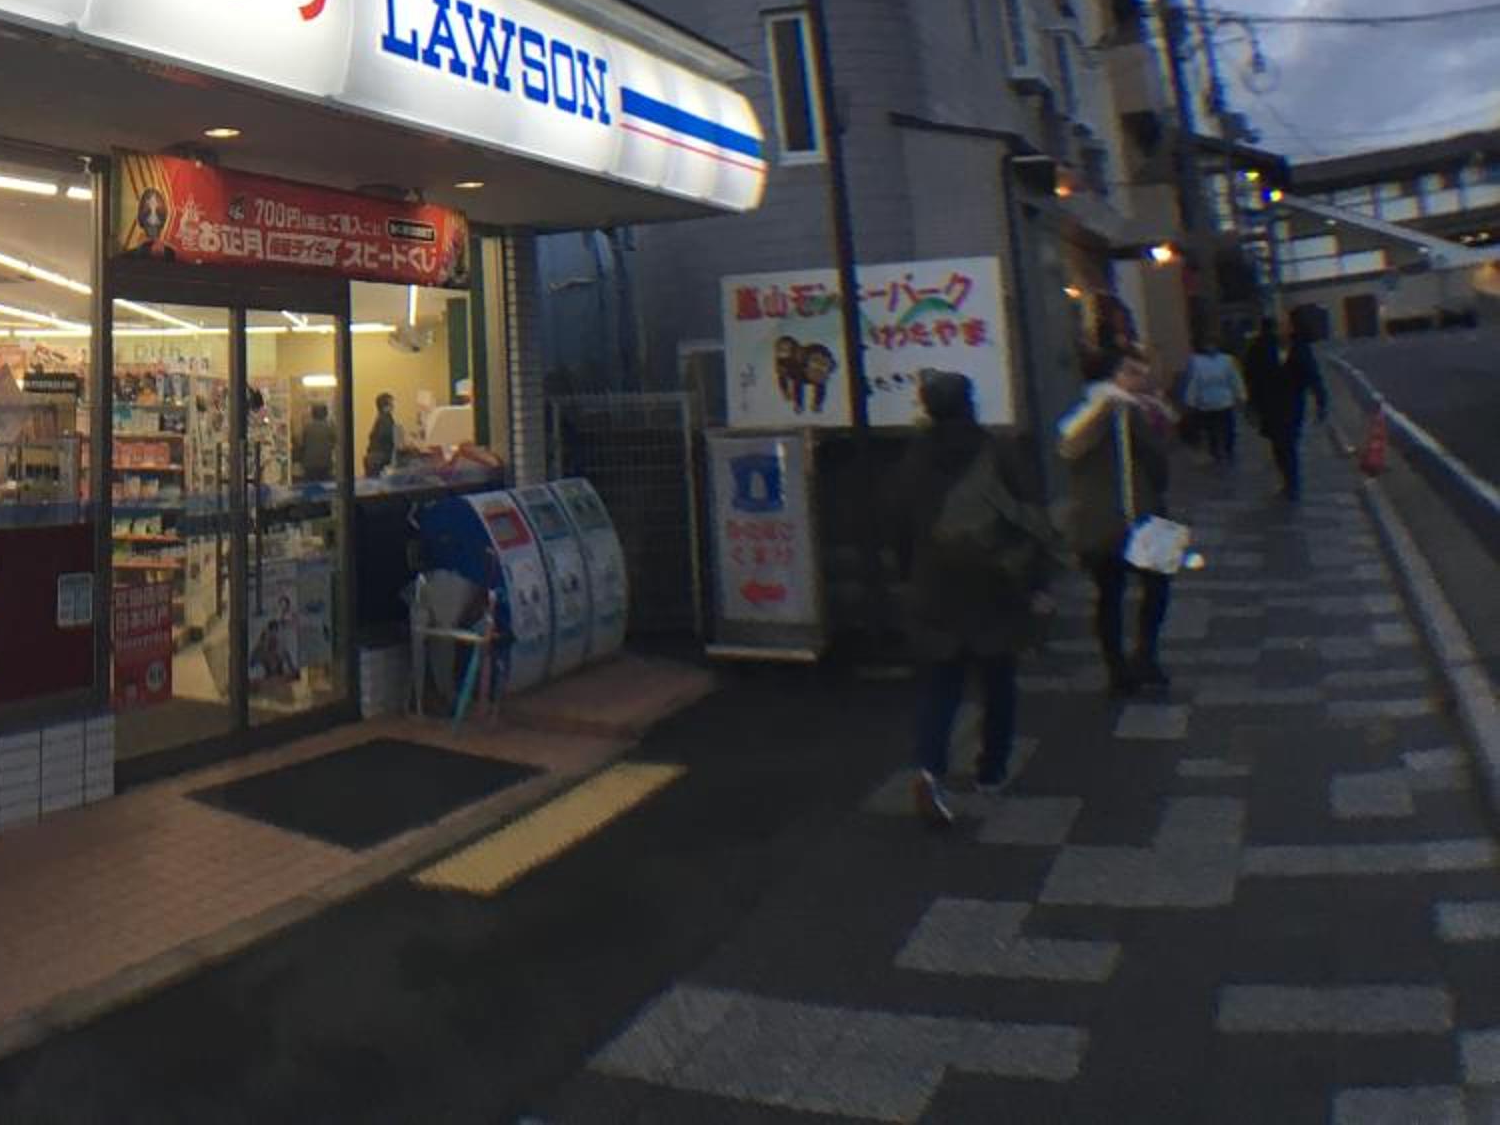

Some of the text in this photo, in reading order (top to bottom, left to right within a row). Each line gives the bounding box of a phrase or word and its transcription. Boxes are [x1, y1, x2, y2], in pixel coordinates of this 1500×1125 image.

[737, 271, 974, 321] 嵐山モンーパーク
